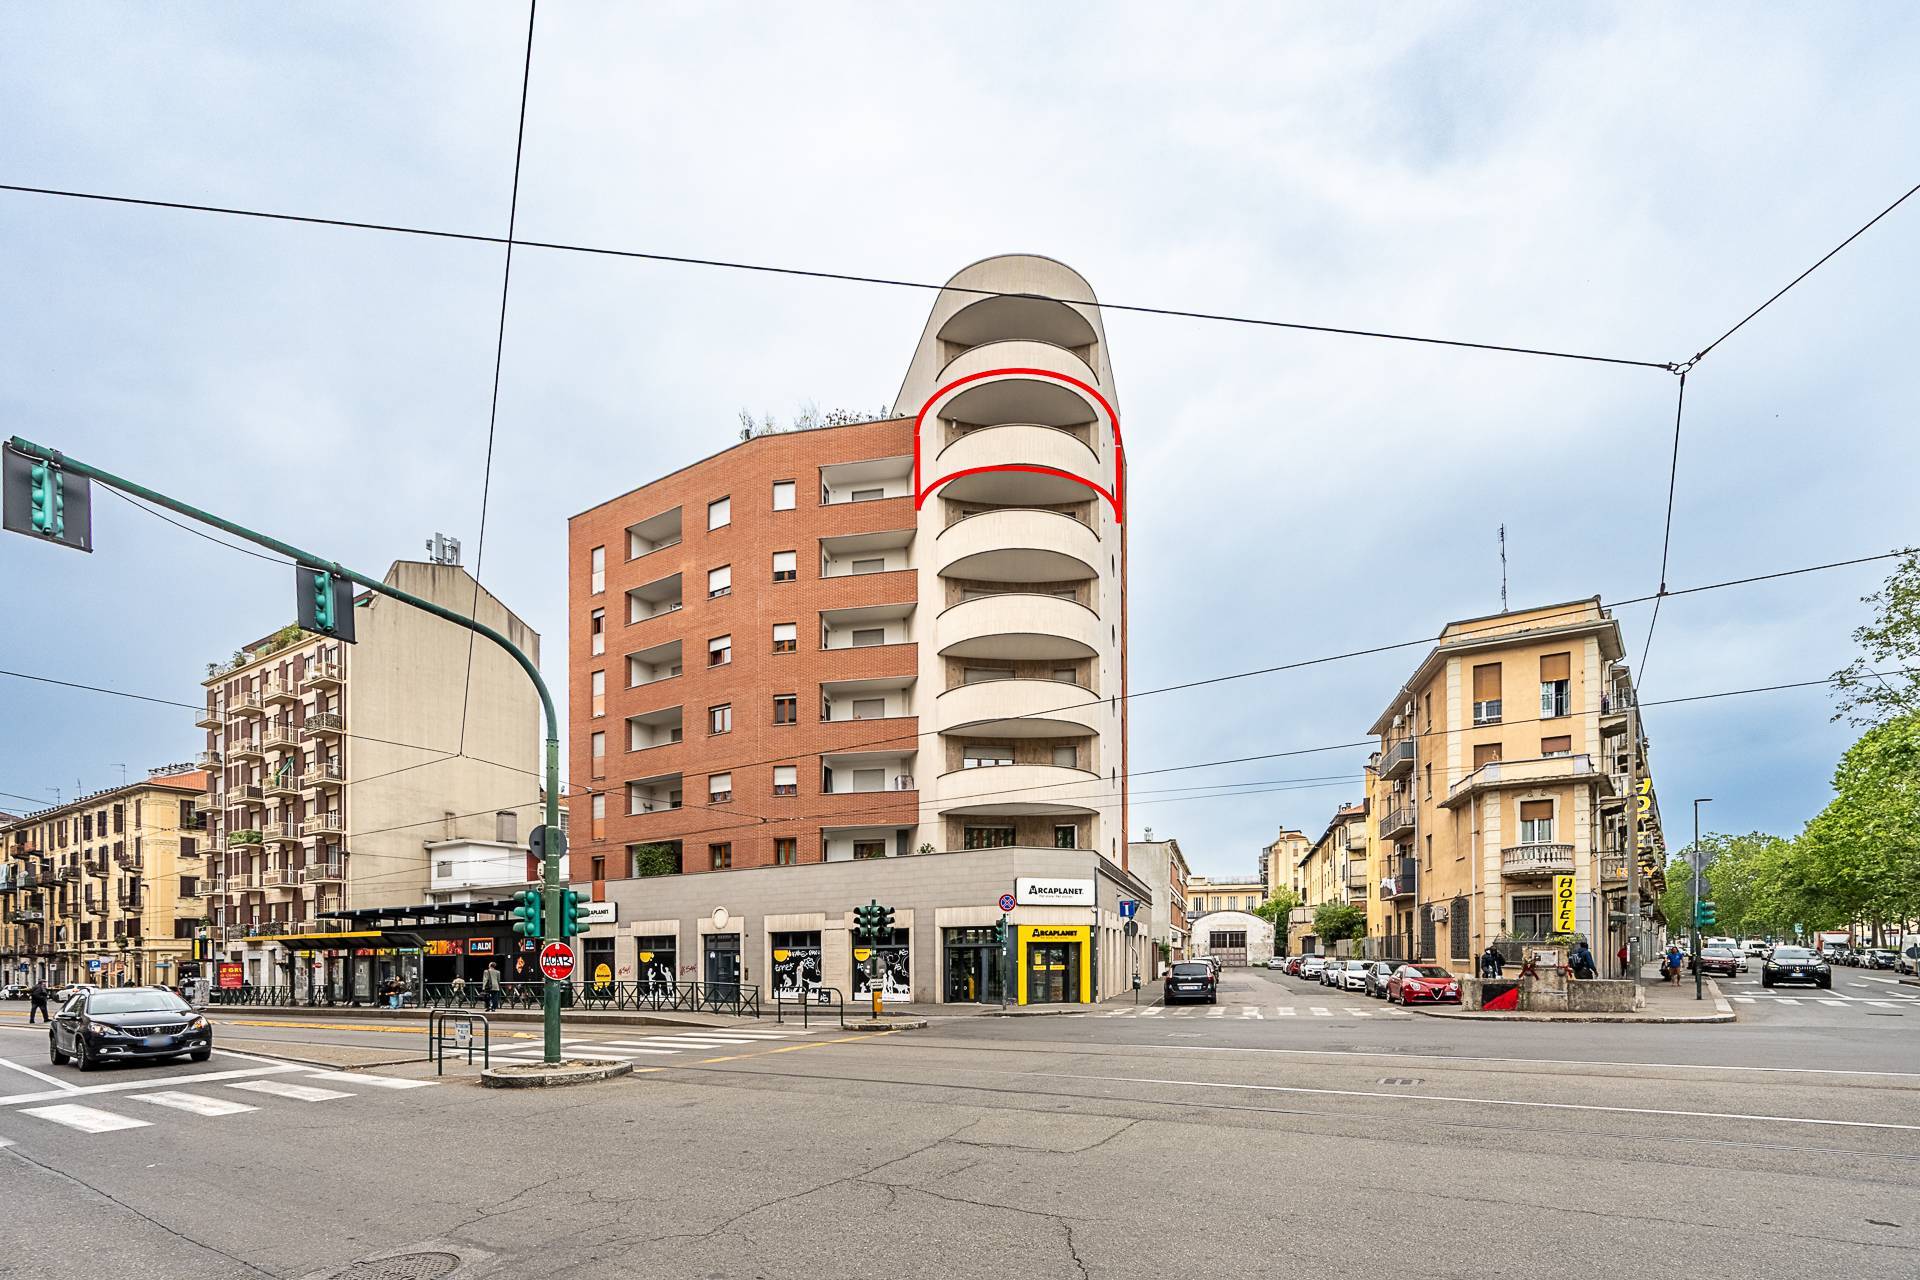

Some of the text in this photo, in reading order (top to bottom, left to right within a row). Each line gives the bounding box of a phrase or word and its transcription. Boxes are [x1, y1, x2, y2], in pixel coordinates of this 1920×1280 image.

[1029, 885, 1083, 894] ARCAPLANET
[1559, 878, 1573, 930] HOTEL
[1032, 929, 1077, 937] ARCAPLANET
[477, 942, 492, 951] ALDI
